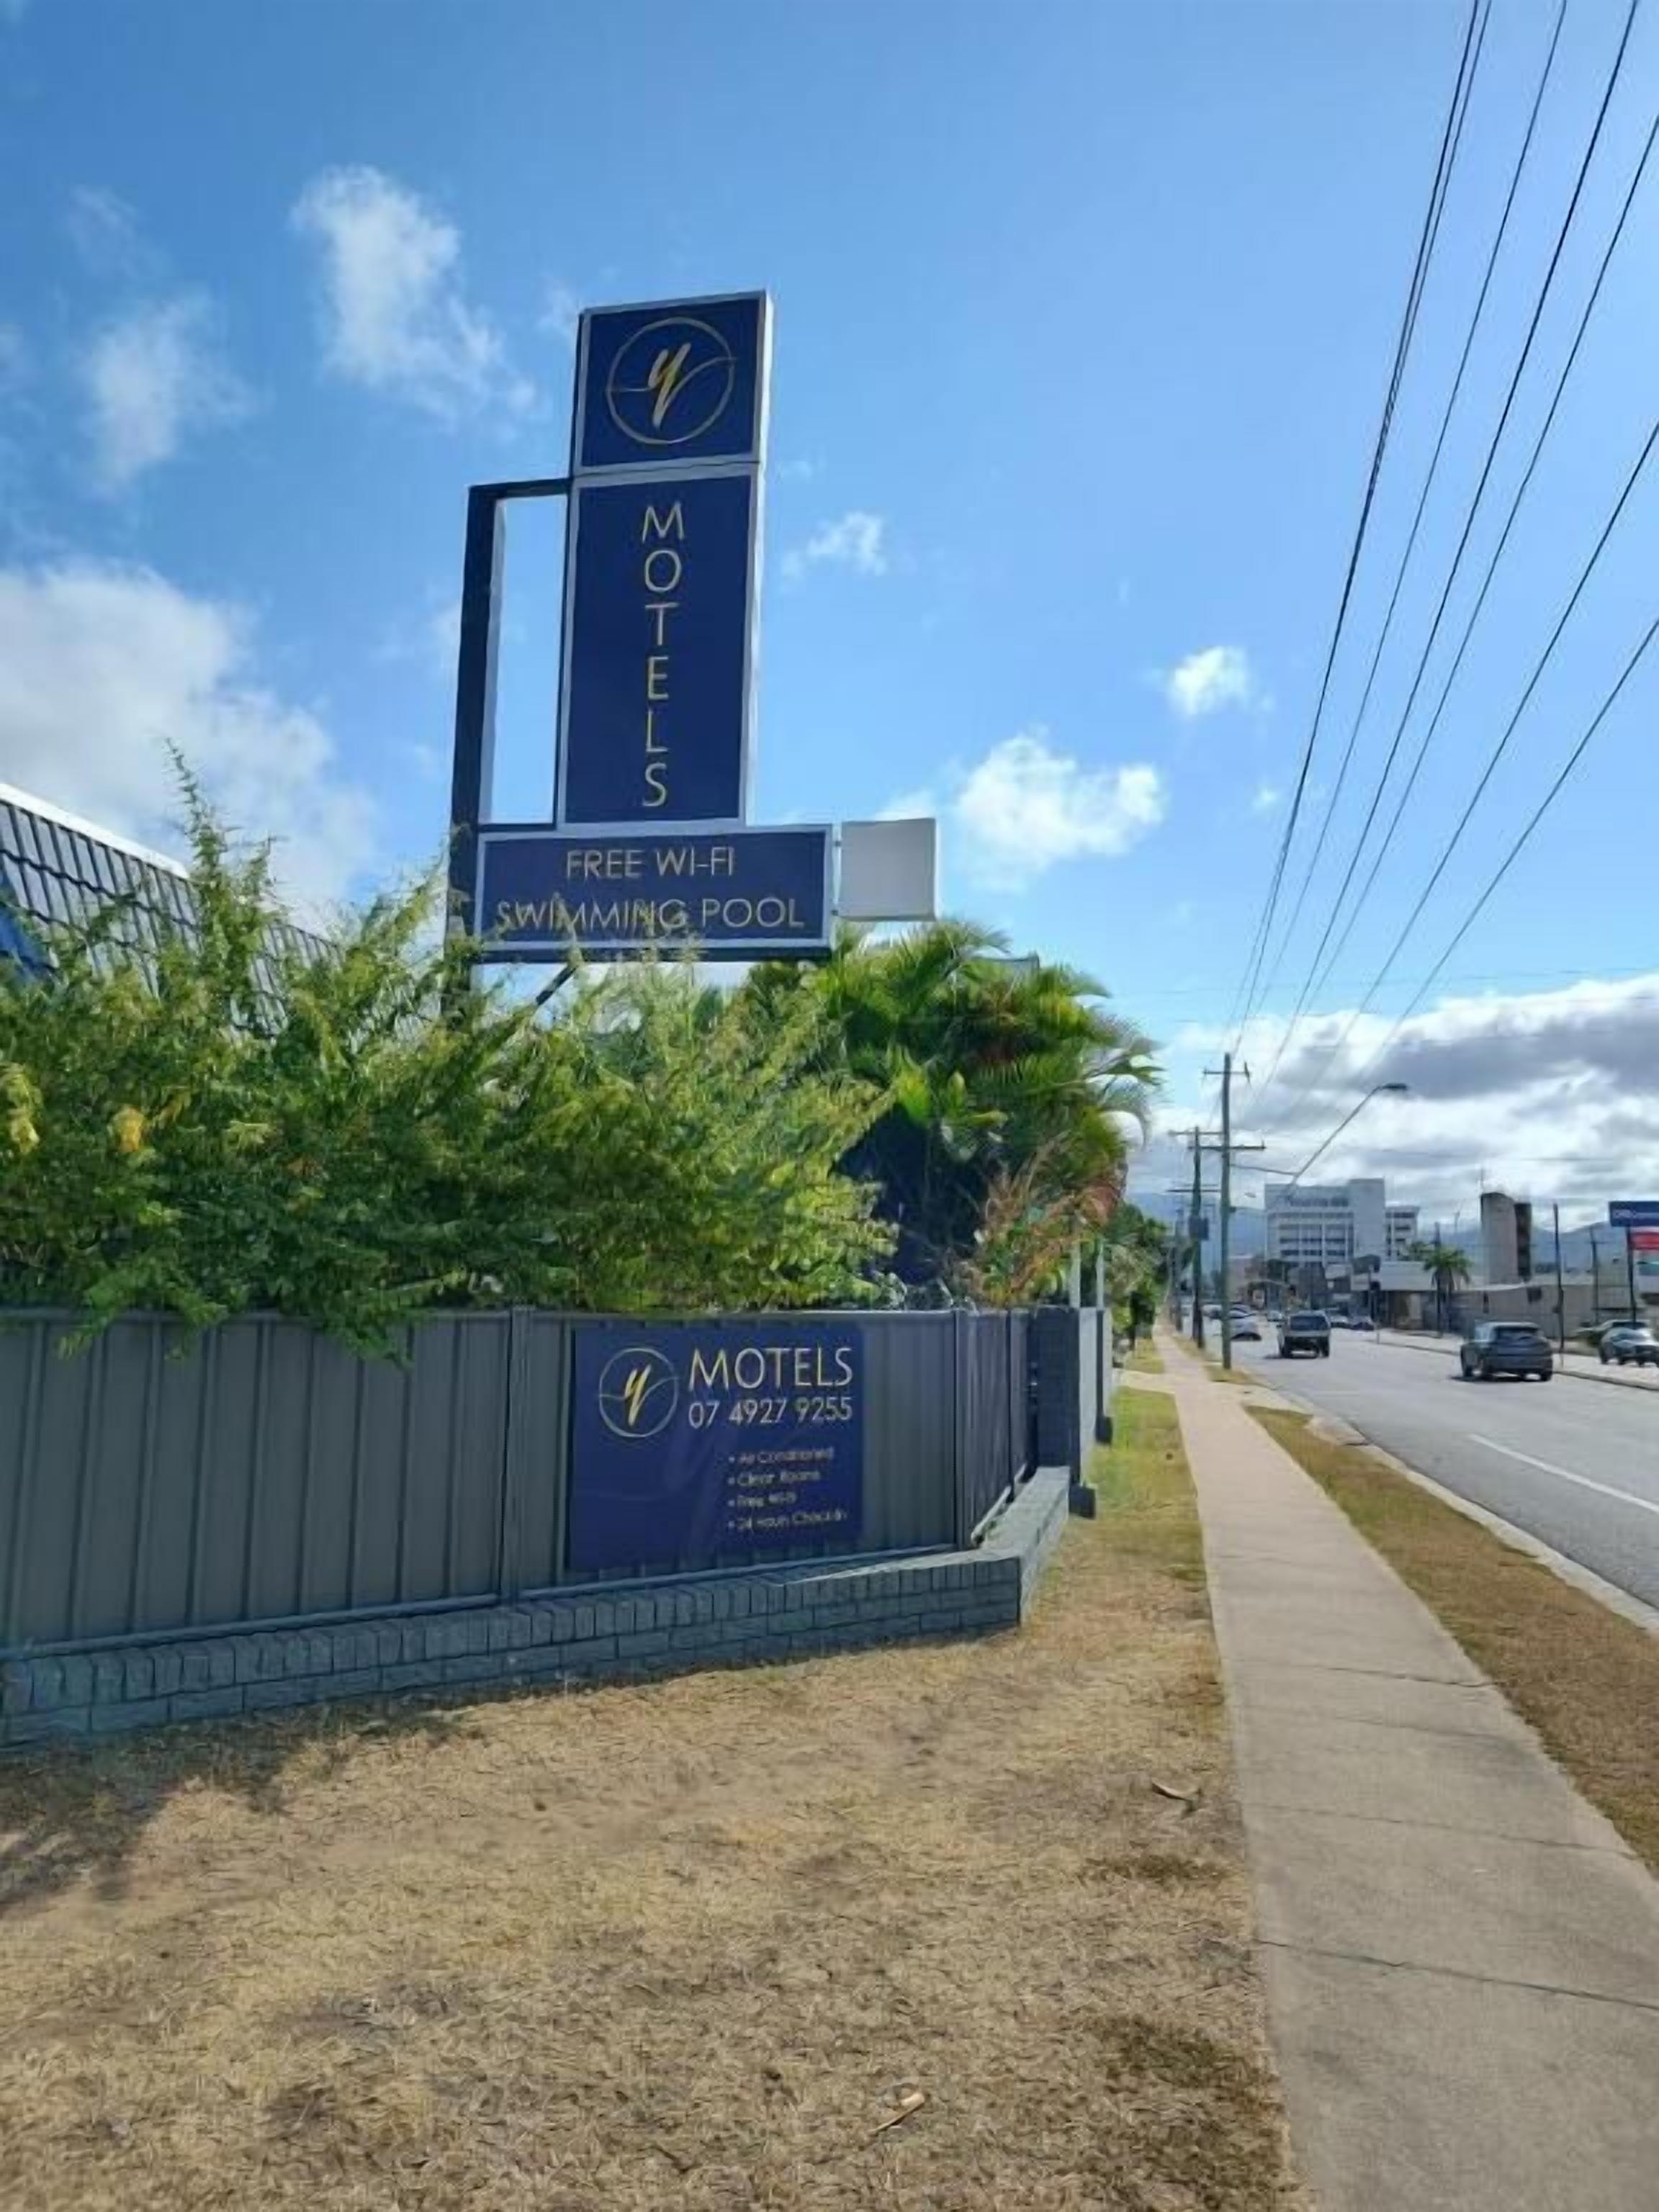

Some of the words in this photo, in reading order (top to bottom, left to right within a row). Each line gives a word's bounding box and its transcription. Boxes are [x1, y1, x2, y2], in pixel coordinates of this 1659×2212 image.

[642, 502, 685, 807] MOTELS
[566, 849, 644, 880] FREE
[655, 846, 734, 876] WI-FI
[701, 897, 805, 929] POOL
[688, 1347, 853, 1390] MOTELS
[688, 1401, 719, 1429] 07
[729, 1398, 786, 1425] 4927
[795, 1397, 853, 1424] 9255
